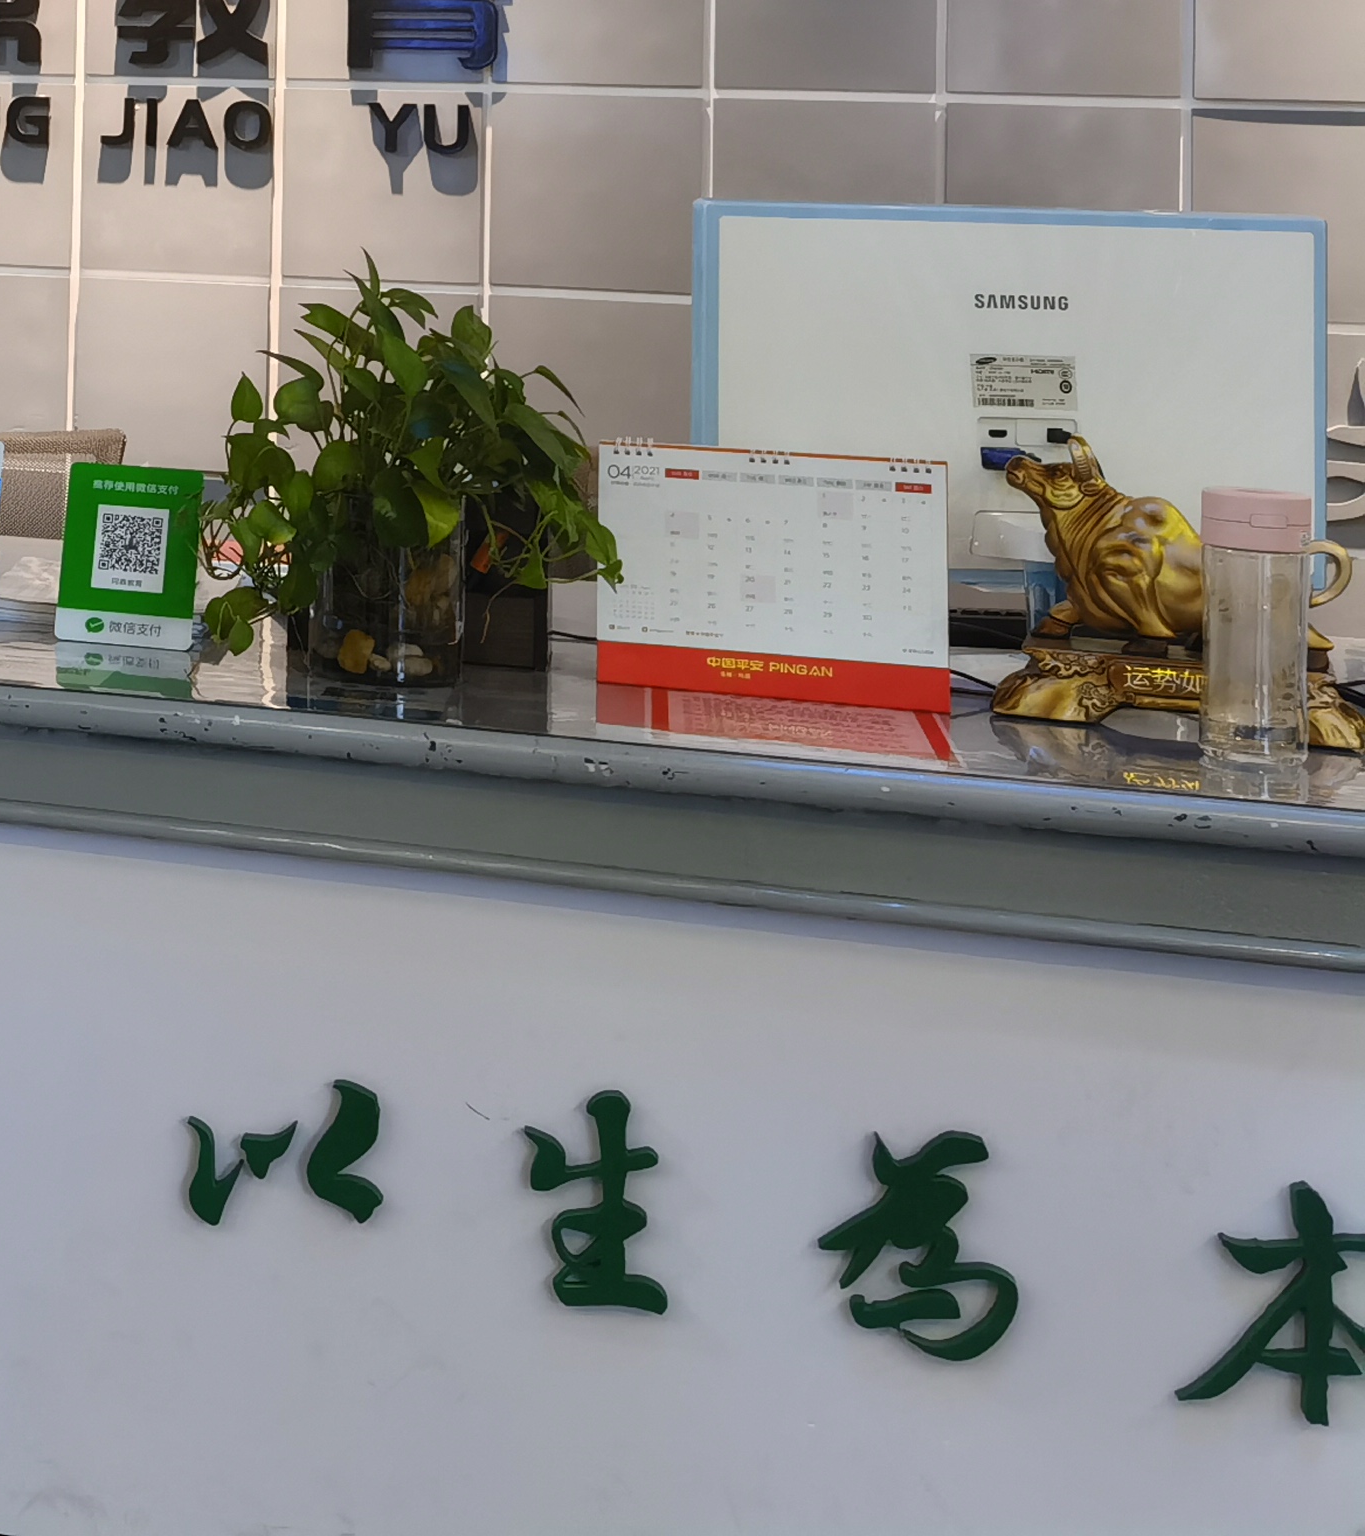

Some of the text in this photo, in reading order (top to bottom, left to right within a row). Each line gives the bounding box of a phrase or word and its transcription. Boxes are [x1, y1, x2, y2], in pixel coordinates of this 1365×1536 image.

[101, 96, 272, 152] JIAO
[370, 101, 472, 155] YU
[973, 293, 1070, 311] SAMSUNG
[607, 464, 660, 480] 04 2021
[108, 620, 162, 638] 微信支付
[706, 656, 765, 672] 中国平安
